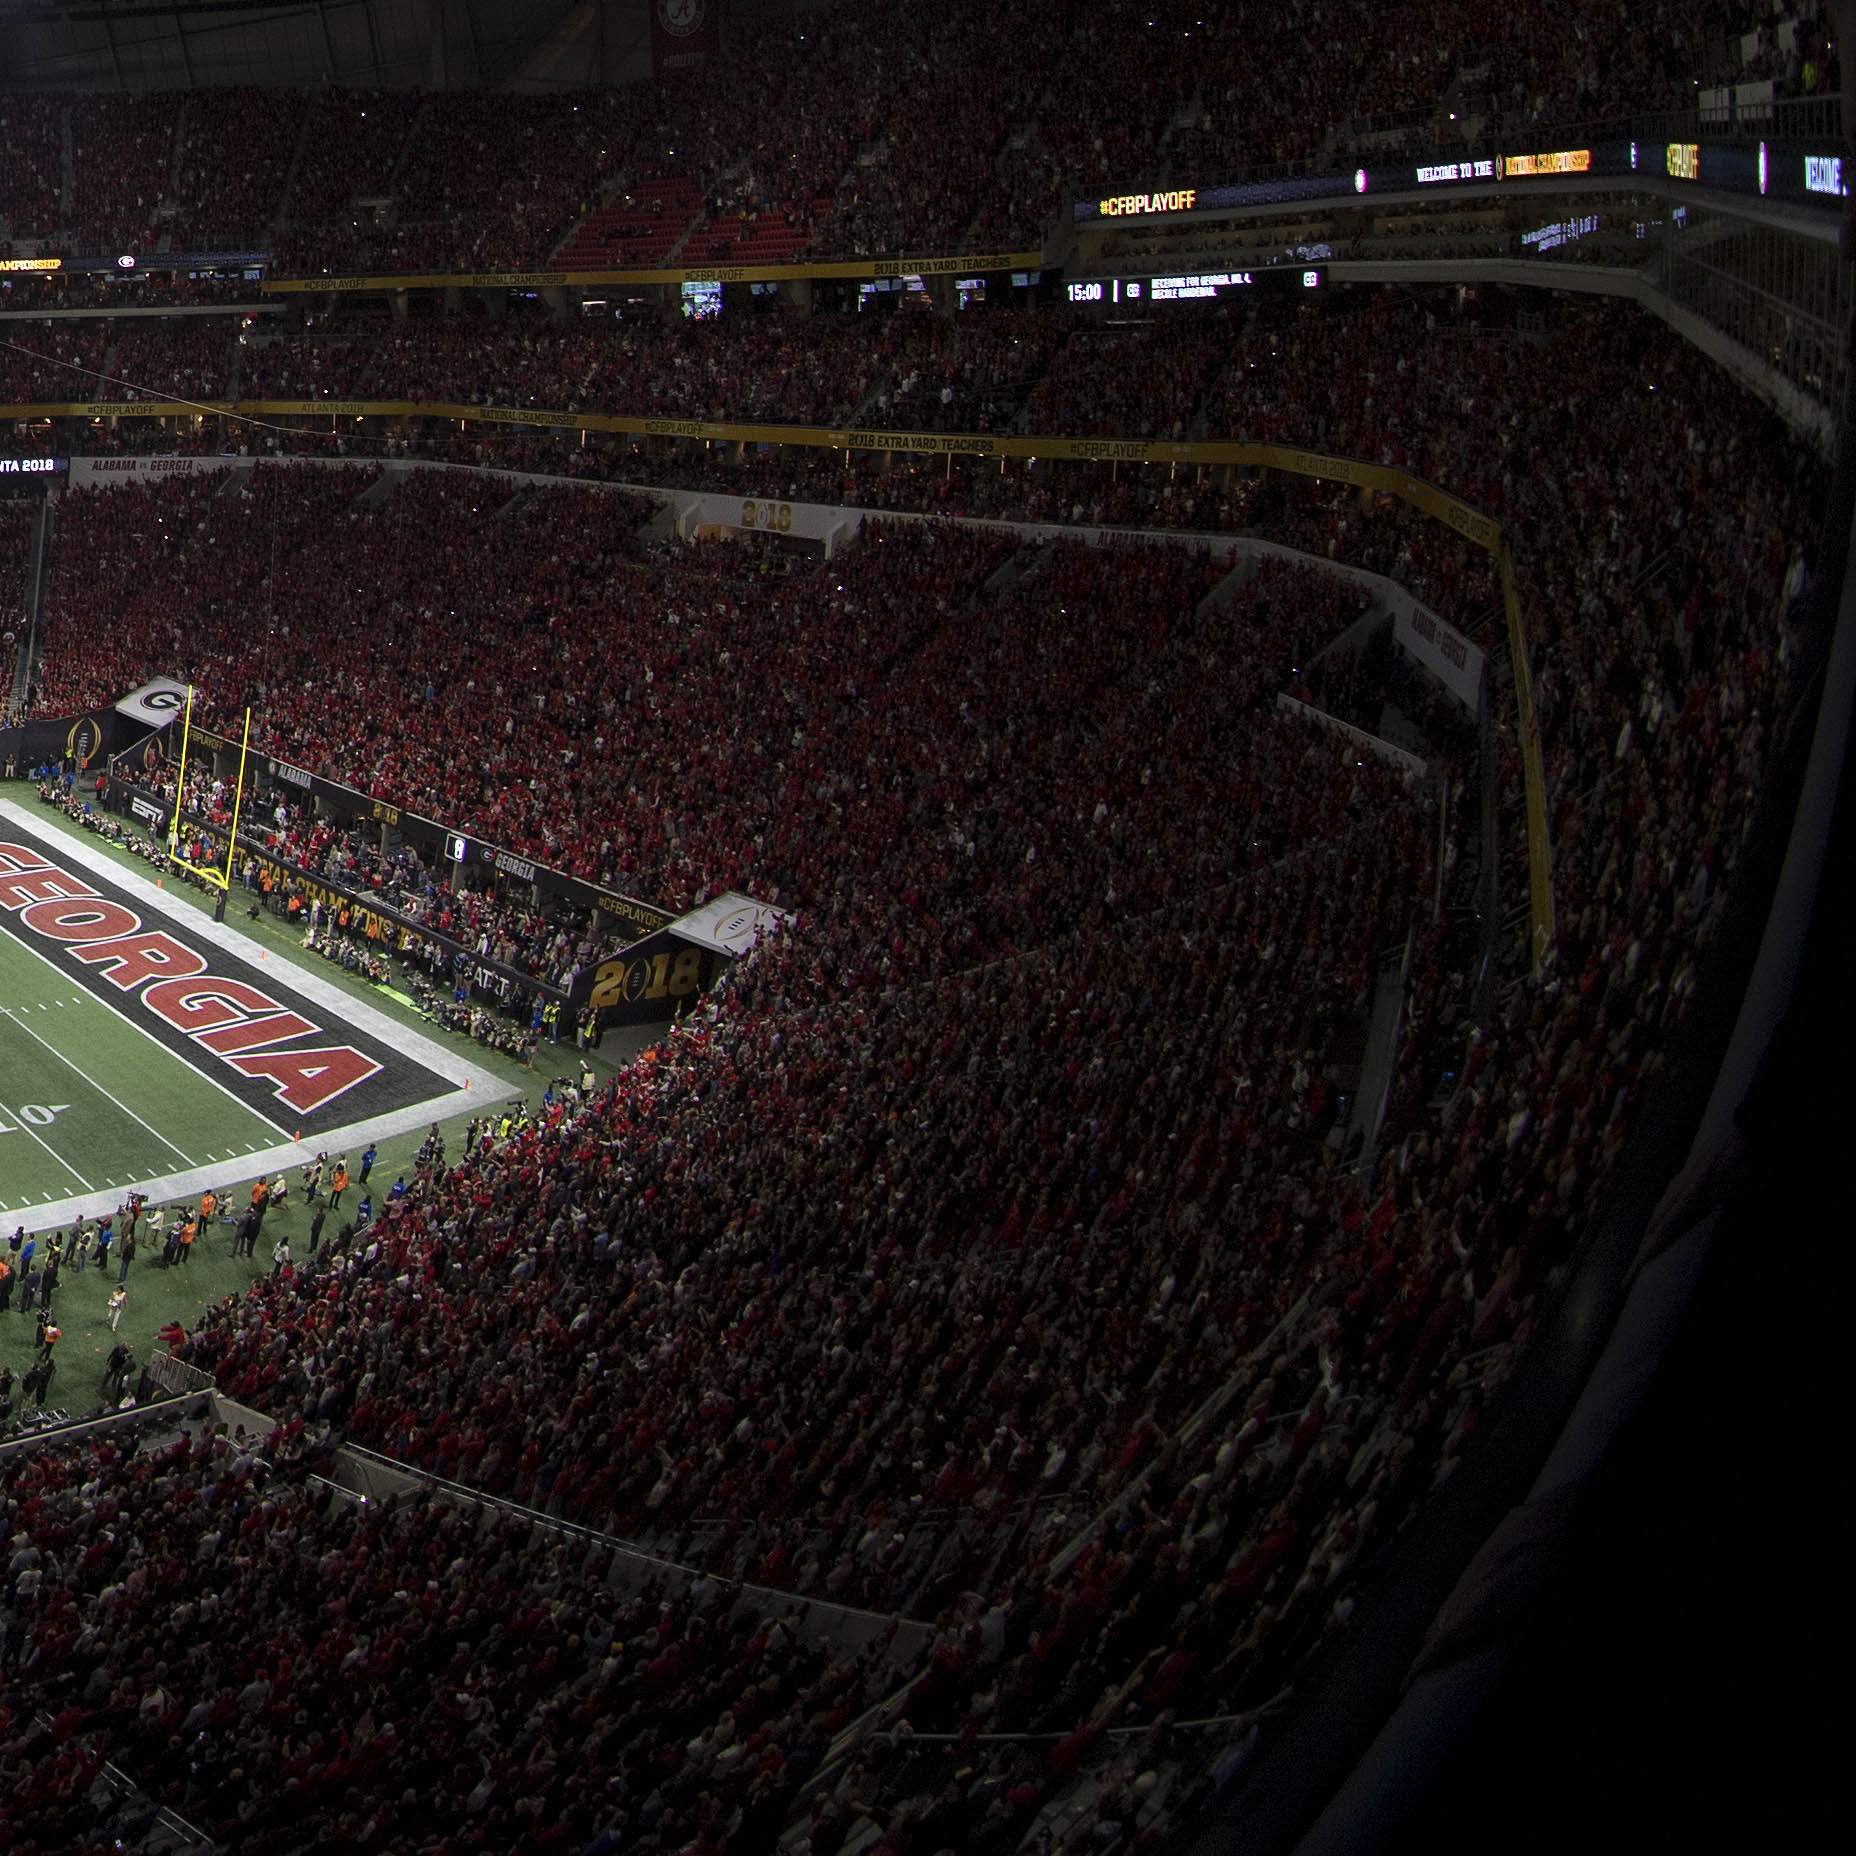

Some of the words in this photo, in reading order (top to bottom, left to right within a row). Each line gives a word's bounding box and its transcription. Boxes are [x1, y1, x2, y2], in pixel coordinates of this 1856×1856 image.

[1417, 165, 1458, 182] WELCOME
[1460, 163, 1473, 178] TO
[1474, 161, 1493, 176] THE
[1100, 189, 1197, 216] #CFBPLAYOFF
[874, 262, 900, 275] 2018
[901, 261, 931, 274] EXTRA
[933, 259, 957, 272] YARD
[961, 256, 1011, 270] TEACHERS
[685, 269, 744, 282] #CFBPLAYOFF
[1068, 284, 1102, 301] 15:00
[88, 405, 155, 415] #CFBPLAYOFF
[301, 404, 339, 414] ATLANTA
[480, 408, 517, 422] NATIONAL
[848, 434, 875, 446] 2018
[877, 435, 909, 448] EXTRA
[911, 437, 937, 450] YARD
[940, 439, 994, 452] TEACHERS
[1069, 442, 1149, 459] #CFBPLAYOFF
[22, 459, 54, 472] 2018
[92, 460, 136, 470] ALABAMA
[150, 460, 193, 470] GEORGIA
[278, 766, 312, 789] ALABAMA
[132, 796, 162, 822] ESPN
[495, 853, 536, 882] GEORGIA
[599, 897, 664, 928] #CFBPLAYOFF
